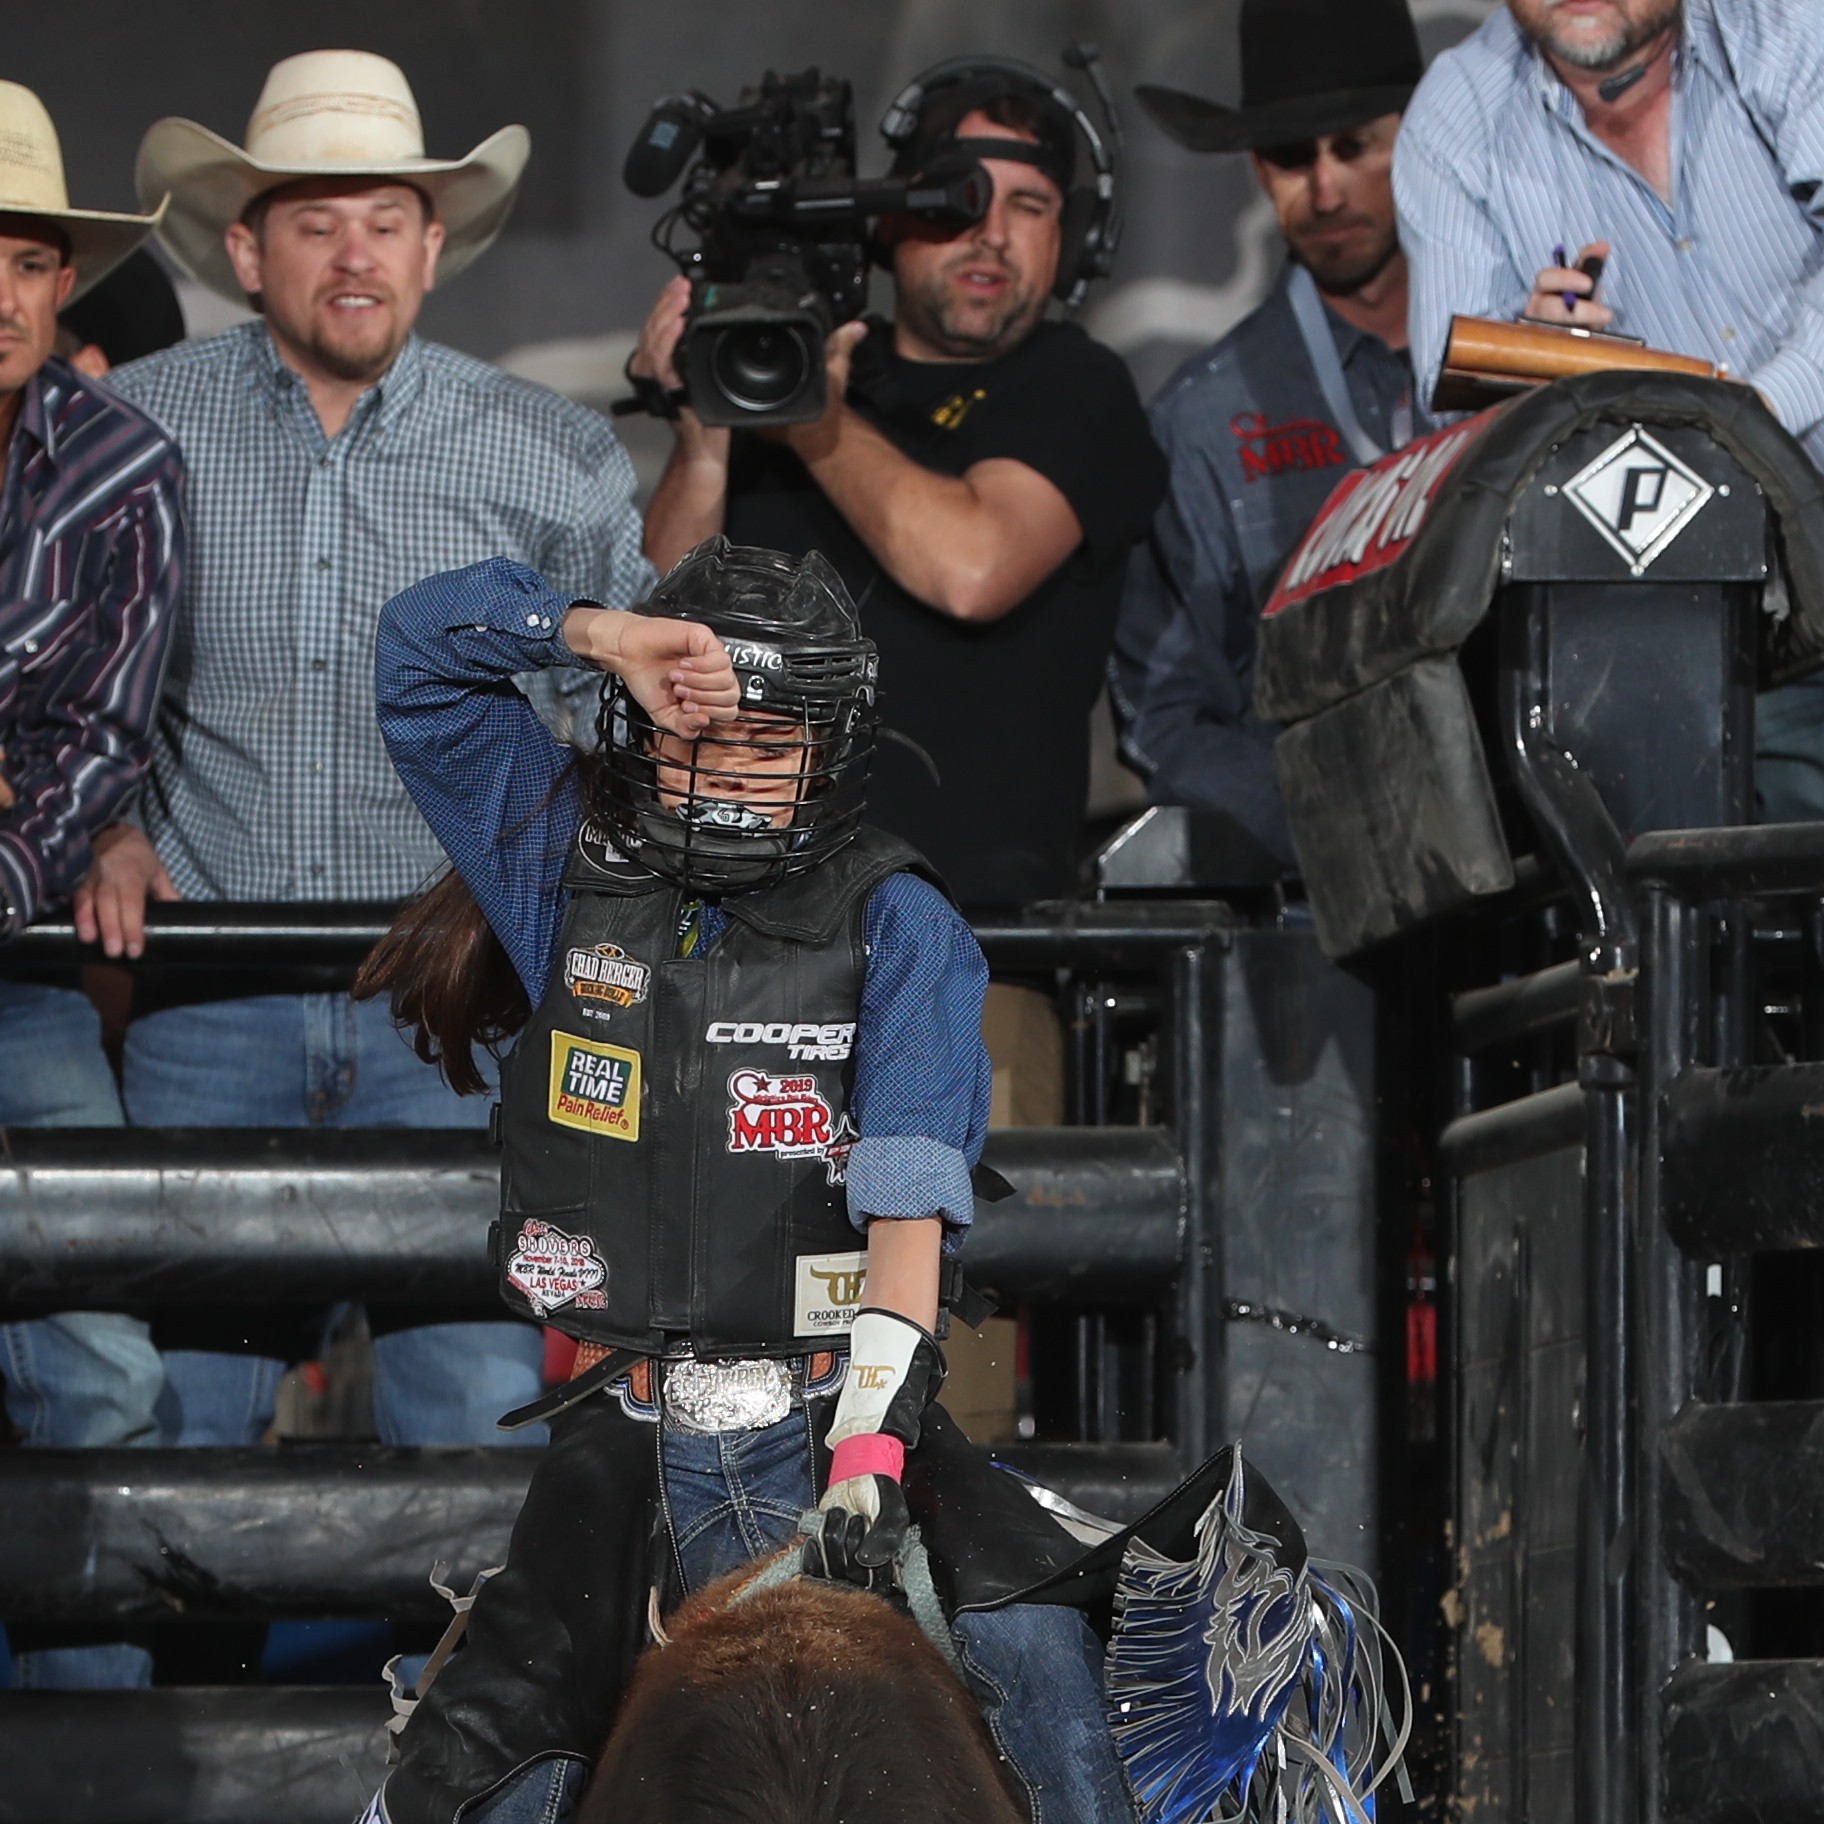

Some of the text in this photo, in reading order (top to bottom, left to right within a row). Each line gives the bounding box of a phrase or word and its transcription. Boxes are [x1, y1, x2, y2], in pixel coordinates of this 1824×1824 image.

[725, 644, 782, 670] ISTIC
[706, 1022, 857, 1045] COOPER
[787, 1044, 852, 1060] TIRES
[571, 1051, 624, 1082] REAL
[569, 1071, 623, 1103] TIME
[780, 1079, 813, 1093] 2019
[557, 1094, 584, 1116] Pain
[732, 1106, 830, 1149] MBR
[518, 1237, 590, 1255] SHIVERS
[530, 1277, 546, 1289] LAS
[549, 1278, 577, 1291] VEGAS
